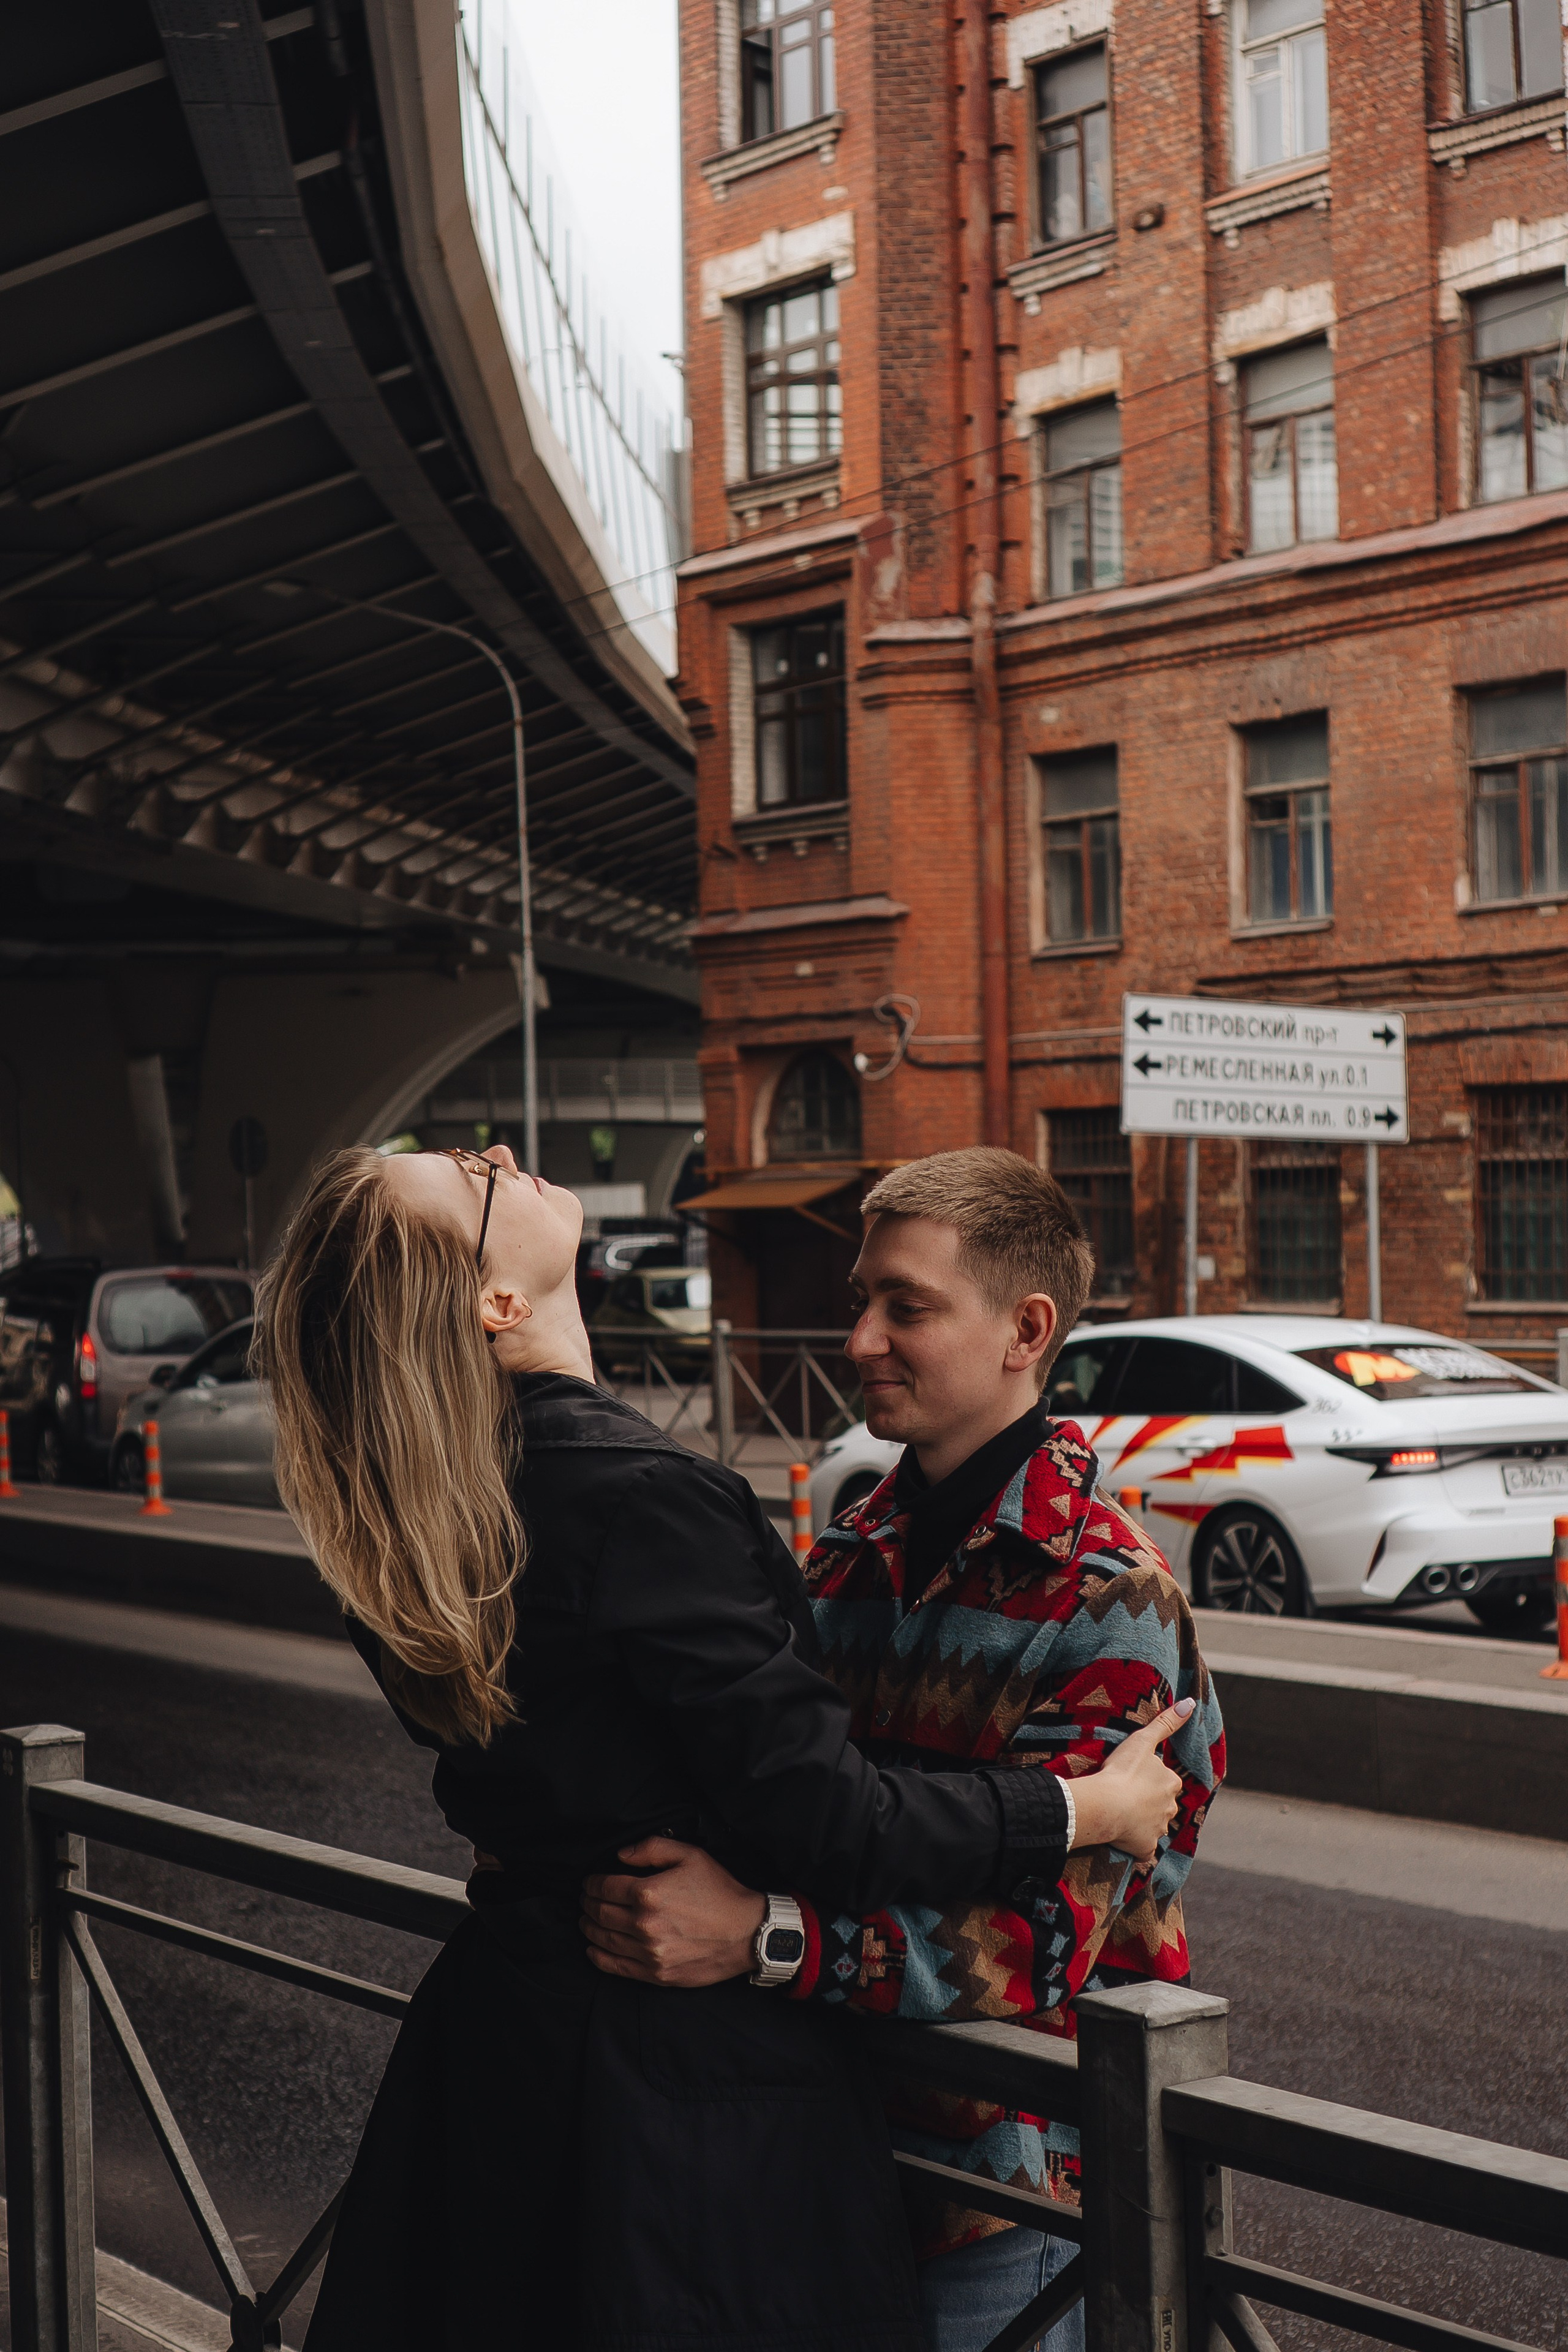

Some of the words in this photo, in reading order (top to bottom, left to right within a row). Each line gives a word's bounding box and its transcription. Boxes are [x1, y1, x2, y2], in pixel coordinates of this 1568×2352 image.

[1170, 1011, 1297, 1040] ПЕТРОВСКИЙ
[1304, 1025, 1338, 1047] пр-т
[1166, 1054, 1314, 1084] РЕМЕСЛЕННАЯ
[1174, 1098, 1304, 1125] ПЕТРОВСКАЯ
